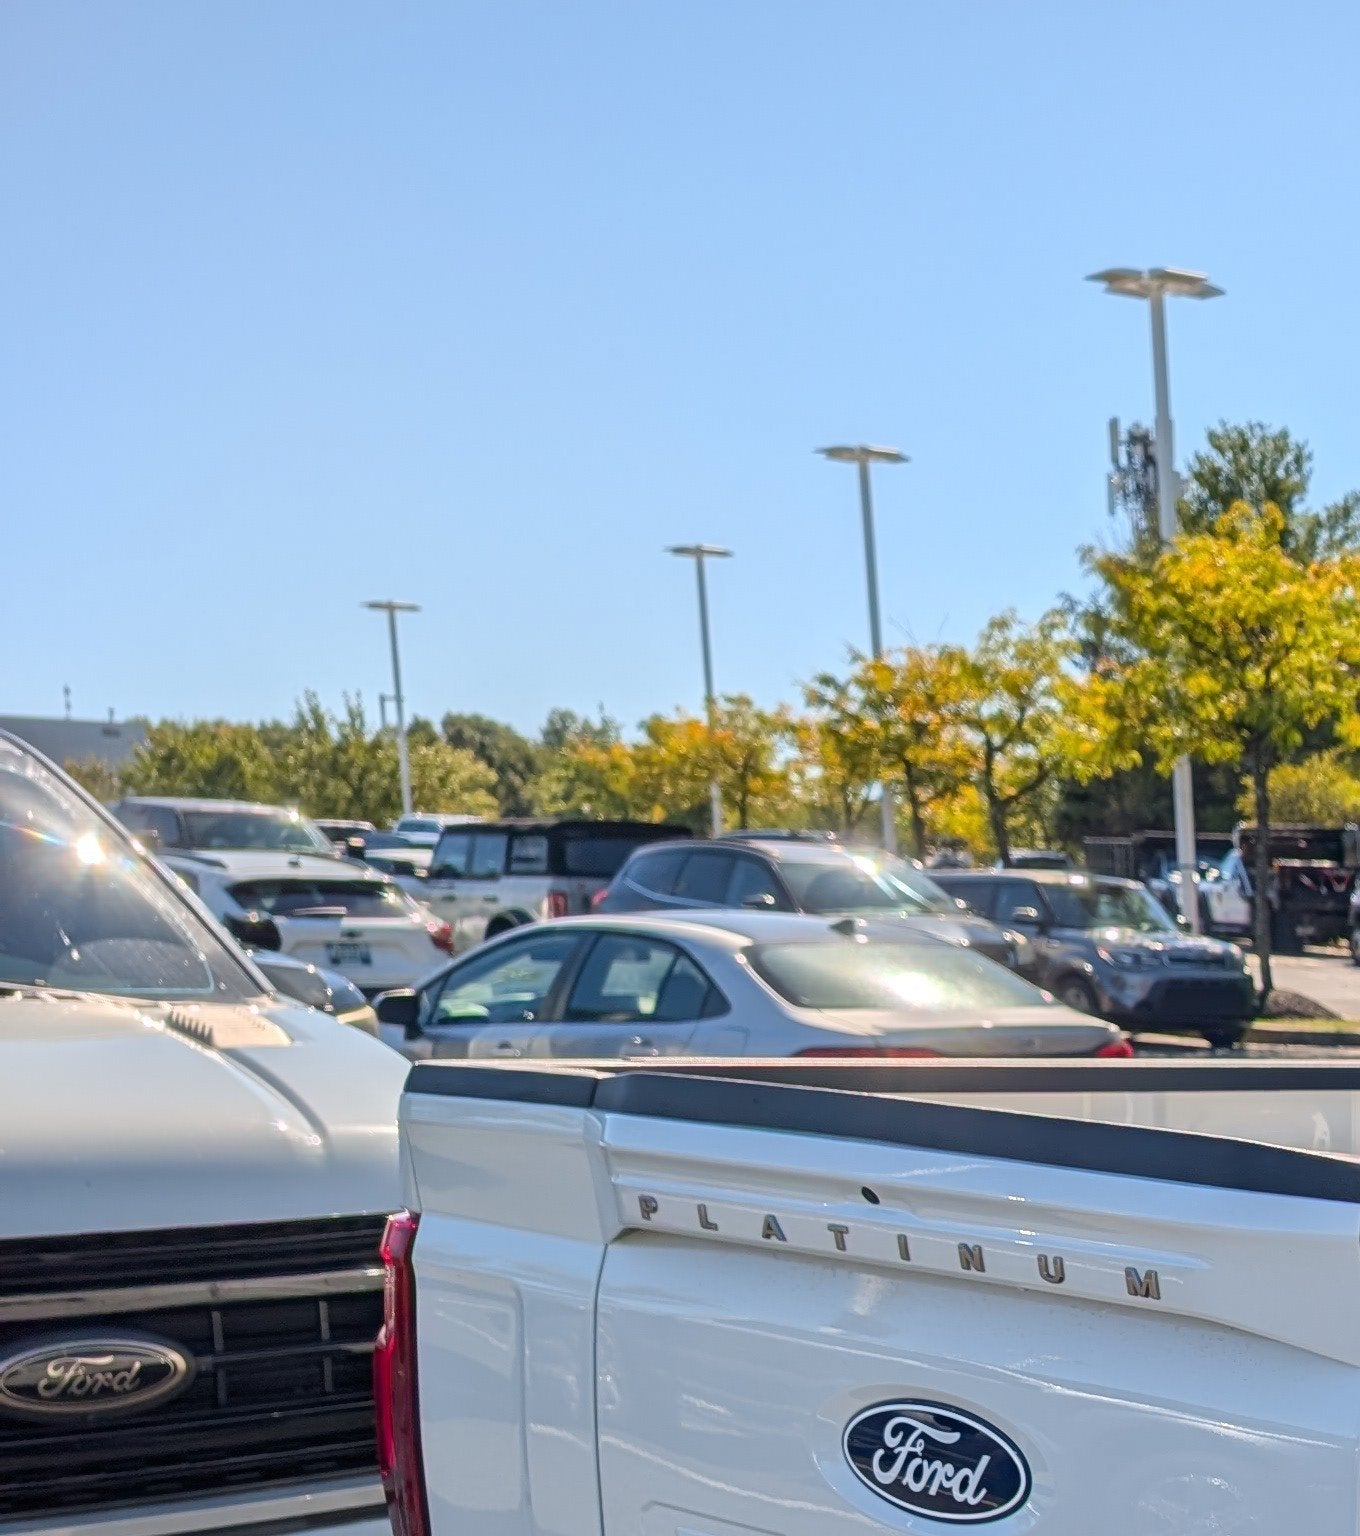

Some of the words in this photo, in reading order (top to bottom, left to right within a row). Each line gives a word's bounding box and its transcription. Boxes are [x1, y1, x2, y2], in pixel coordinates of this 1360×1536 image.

[637, 1194, 1162, 1300] PLATINUM
[36, 1354, 142, 1398] Ford
[872, 1415, 992, 1506] Ford
